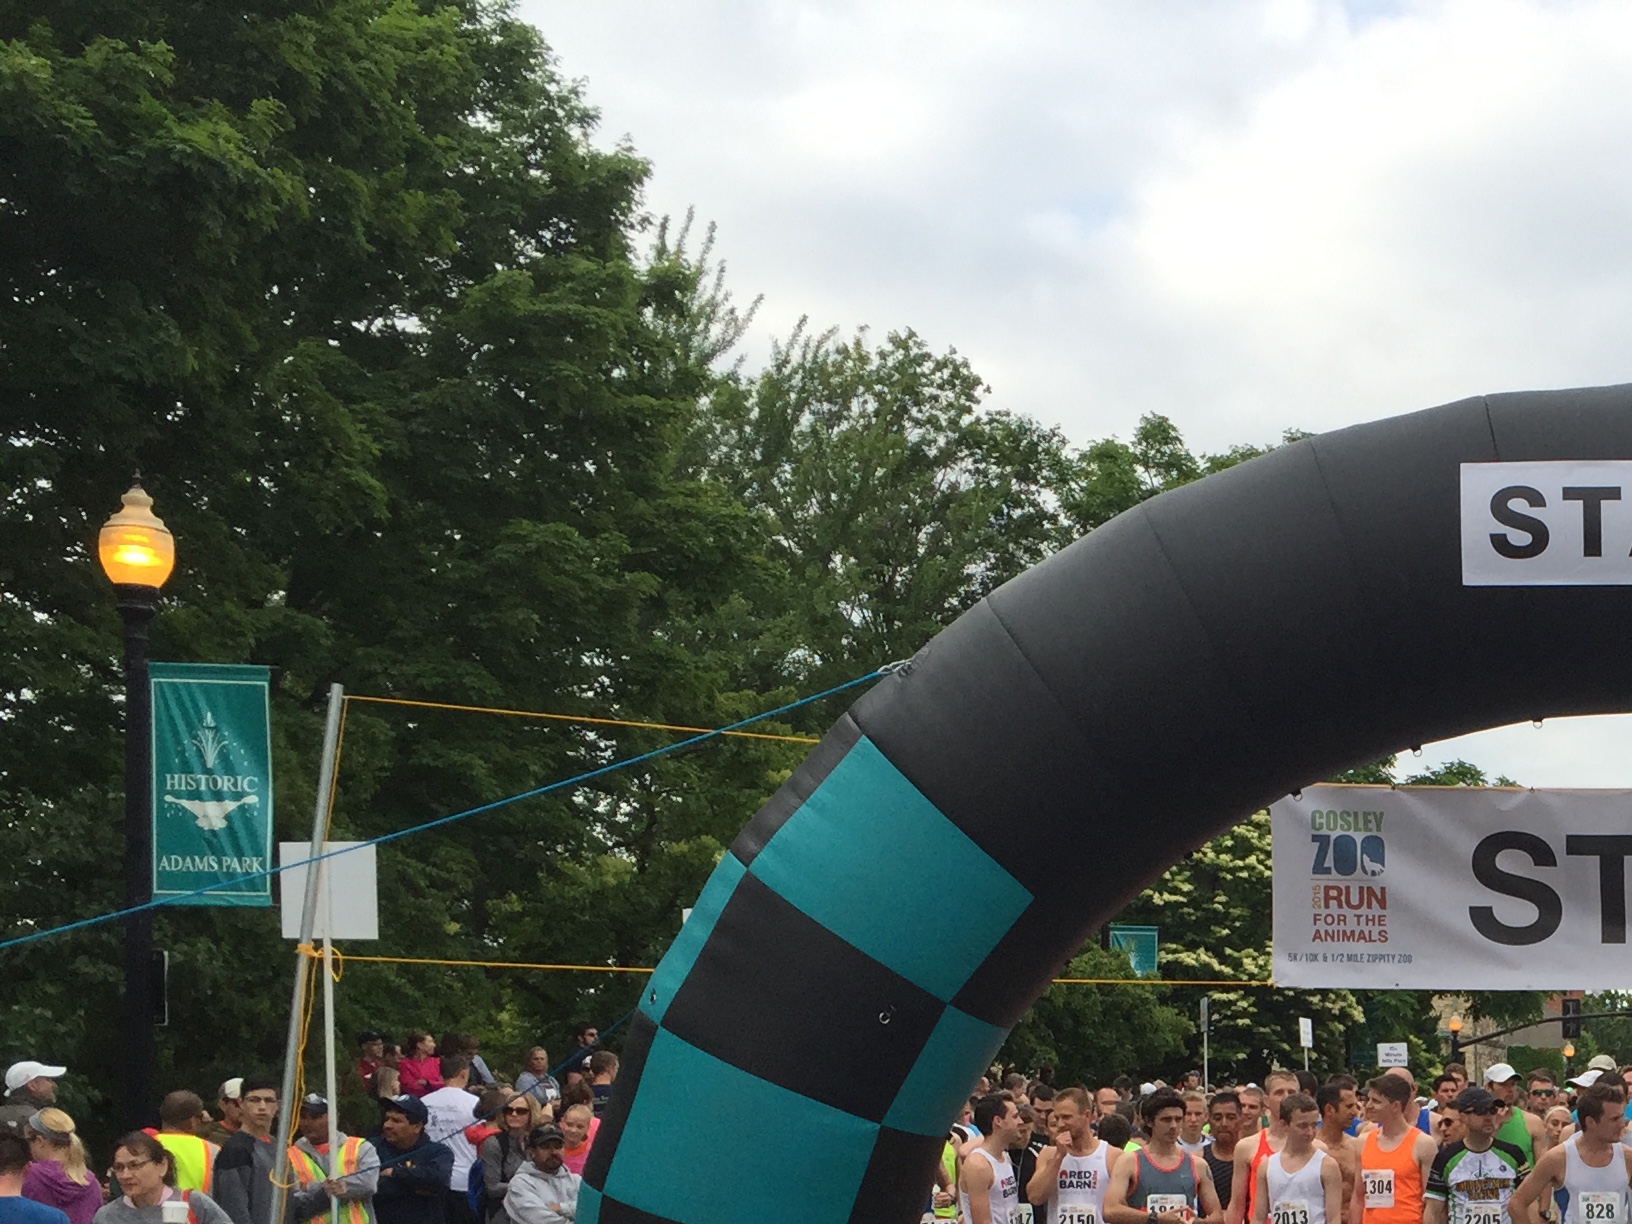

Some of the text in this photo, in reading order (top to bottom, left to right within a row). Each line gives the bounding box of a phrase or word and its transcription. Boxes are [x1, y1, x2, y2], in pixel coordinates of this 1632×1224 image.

[165, 773, 258, 792] HISTORIC
[1311, 810, 1385, 832] COSLEY
[1311, 834, 1385, 876] ZOO
[159, 856, 265, 873] ADAMS PARK
[1312, 885, 1321, 909] 2015
[1323, 885, 1387, 911] RUN
[1313, 914, 1387, 927] FOR THE
[1312, 929, 1388, 943] ANIMALS
[1068, 1170, 1092, 1179] RED
[1059, 1180, 1092, 1189] BARN
[1586, 1203, 1615, 1219] 828
